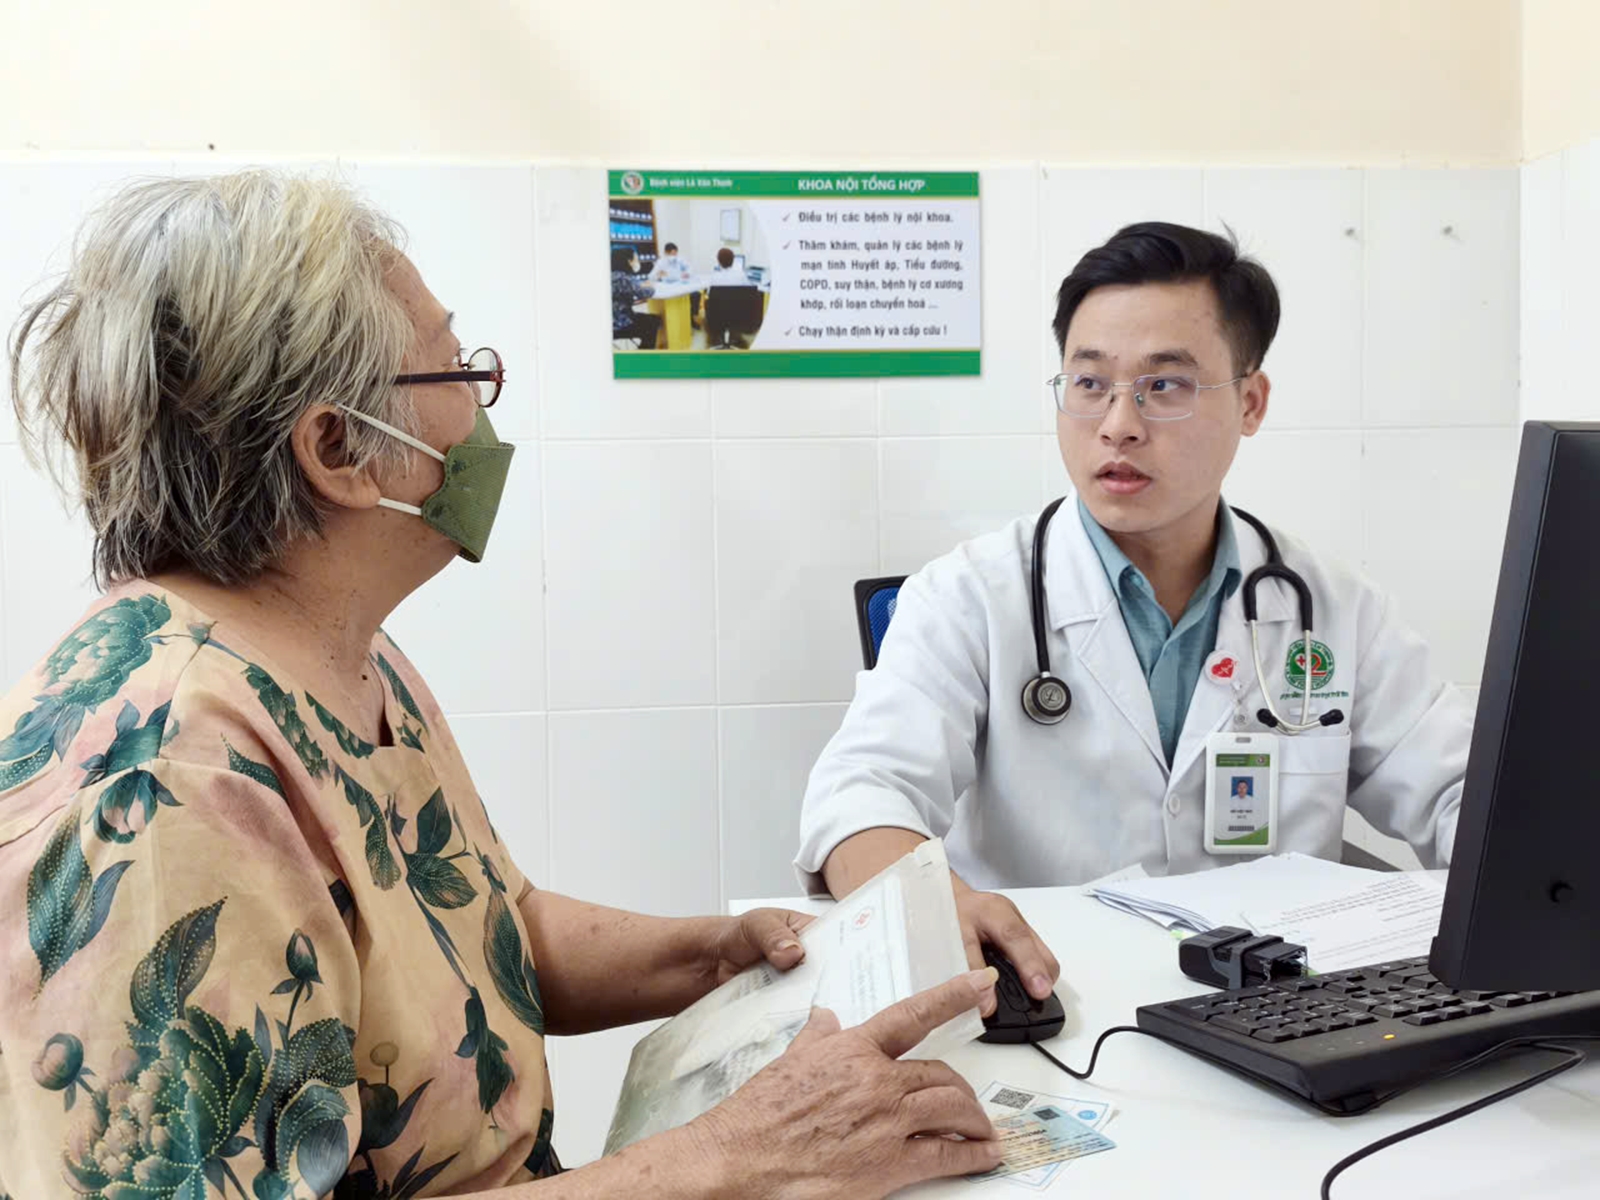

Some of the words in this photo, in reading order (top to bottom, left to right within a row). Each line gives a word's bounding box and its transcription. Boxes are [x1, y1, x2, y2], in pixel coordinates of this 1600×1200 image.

[798, 179, 833, 190] KHOA
[836, 179, 859, 192] NỘI
[861, 175, 895, 190] TỔNG
[899, 179, 926, 192] HỢP
[798, 211, 822, 222] Điều
[826, 212, 837, 223] trị
[842, 212, 860, 222] các
[865, 212, 889, 223] bệnh
[893, 212, 902, 223] lý
[907, 212, 923, 223] nội
[927, 212, 953, 222] khoa.
[799, 240, 826, 250] Thăm
[830, 240, 860, 251] khám,
[865, 240, 888, 252] quản
[892, 240, 901, 252] lý
[905, 240, 923, 250] các
[927, 240, 950, 251] bệnh
[954, 240, 964, 252] lý
[801, 261, 822, 271] mạn
[851, 259, 879, 271] Huyết
[884, 260, 900, 271] áp,
[905, 259, 925, 270] Tiểu
[931, 259, 962, 271] đường,
[800, 279, 831, 290] COPD,
[835, 281, 851, 291] suy
[854, 279, 879, 291] thận,
[882, 279, 905, 290] bệnh
[908, 279, 917, 291] lý
[920, 280, 932, 289] cơ
[934, 280, 963, 291] xương
[801, 299, 826, 310] khớp,
[830, 299, 843, 309] rối
[846, 300, 867, 310] loạn
[870, 298, 904, 310] chuyển
[908, 299, 926, 309] hoá
[799, 326, 823, 338] Chạy
[826, 326, 847, 338] thận
[850, 326, 871, 338] định
[889, 325, 899, 335] và
[903, 325, 920, 337] cấp
[923, 326, 940, 335] cứu
